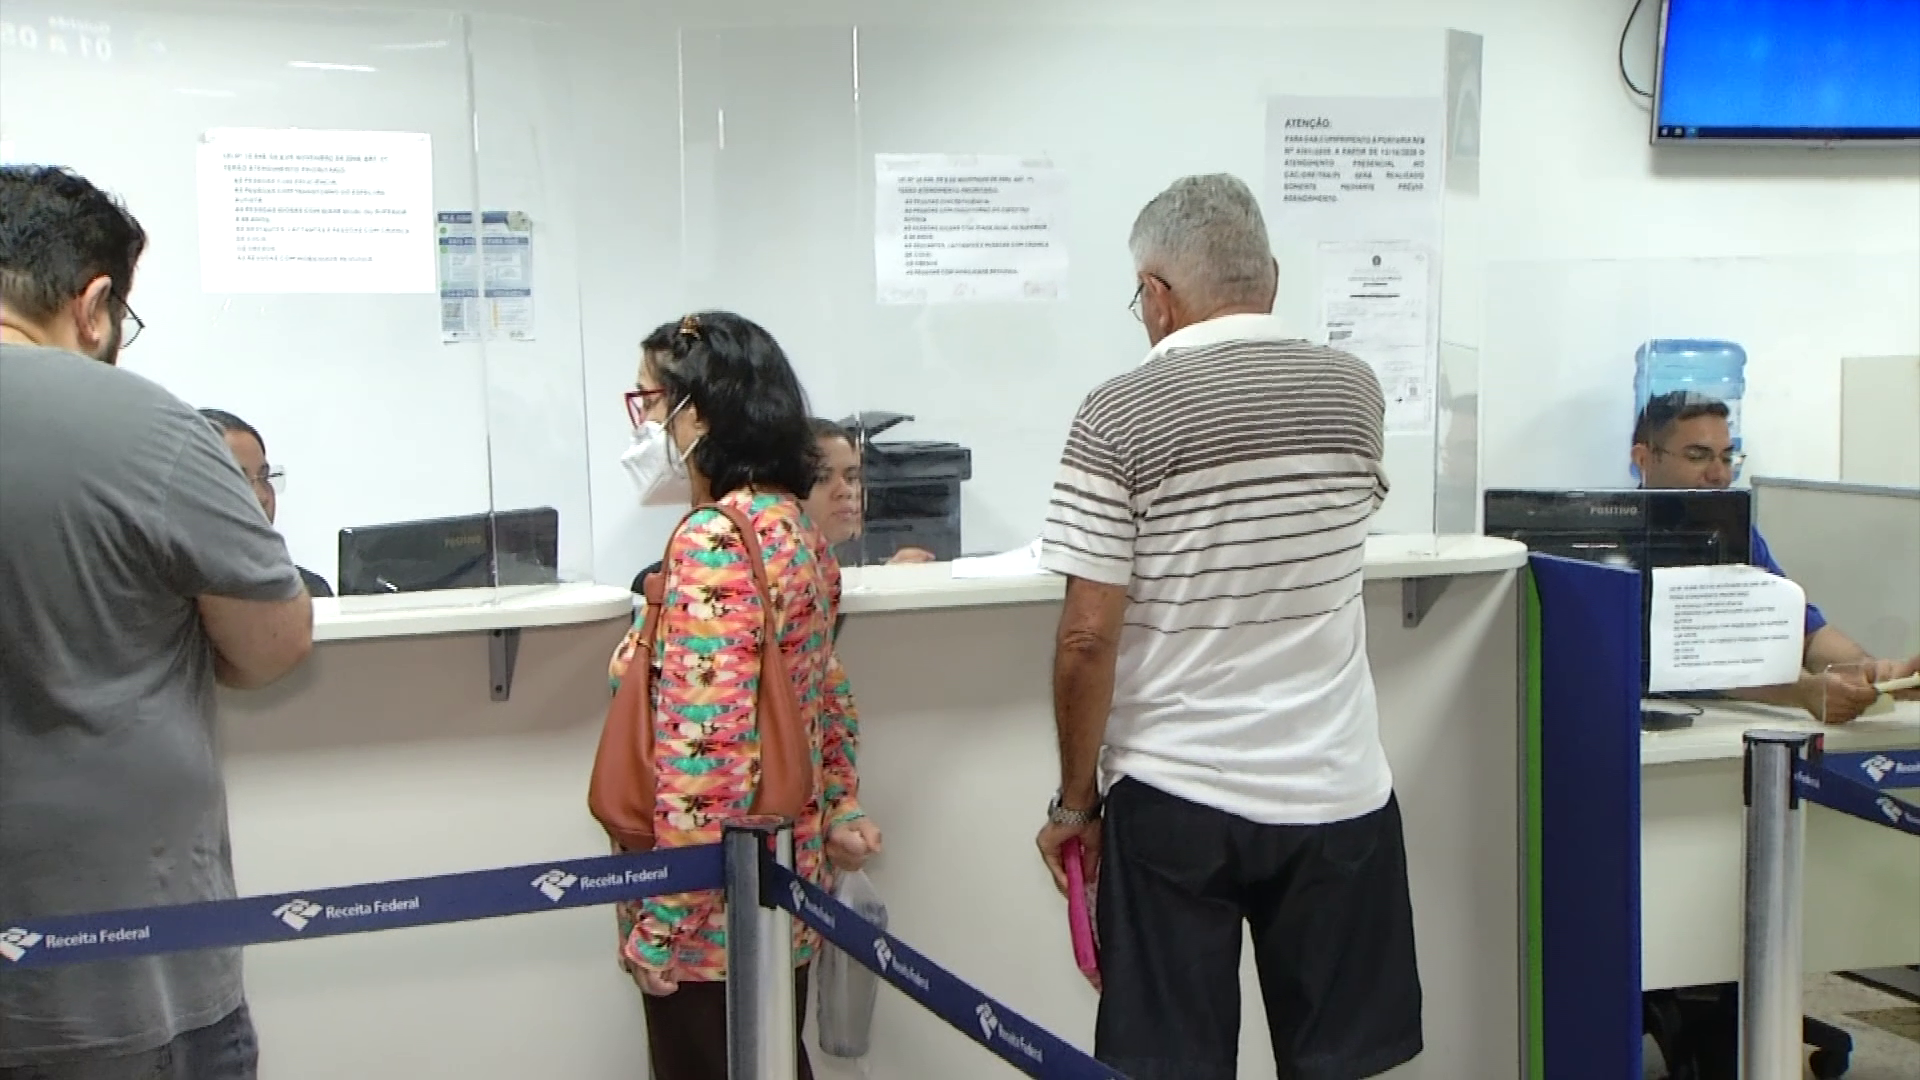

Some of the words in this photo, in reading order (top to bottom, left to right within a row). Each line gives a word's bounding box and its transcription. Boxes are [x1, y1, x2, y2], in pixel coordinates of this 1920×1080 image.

[580, 873, 623, 890] Receita
[625, 866, 668, 884] Federal
[325, 903, 372, 919] Receita
[374, 896, 420, 914] Federal
[45, 932, 97, 949] Receita
[99, 925, 150, 944] Federal
